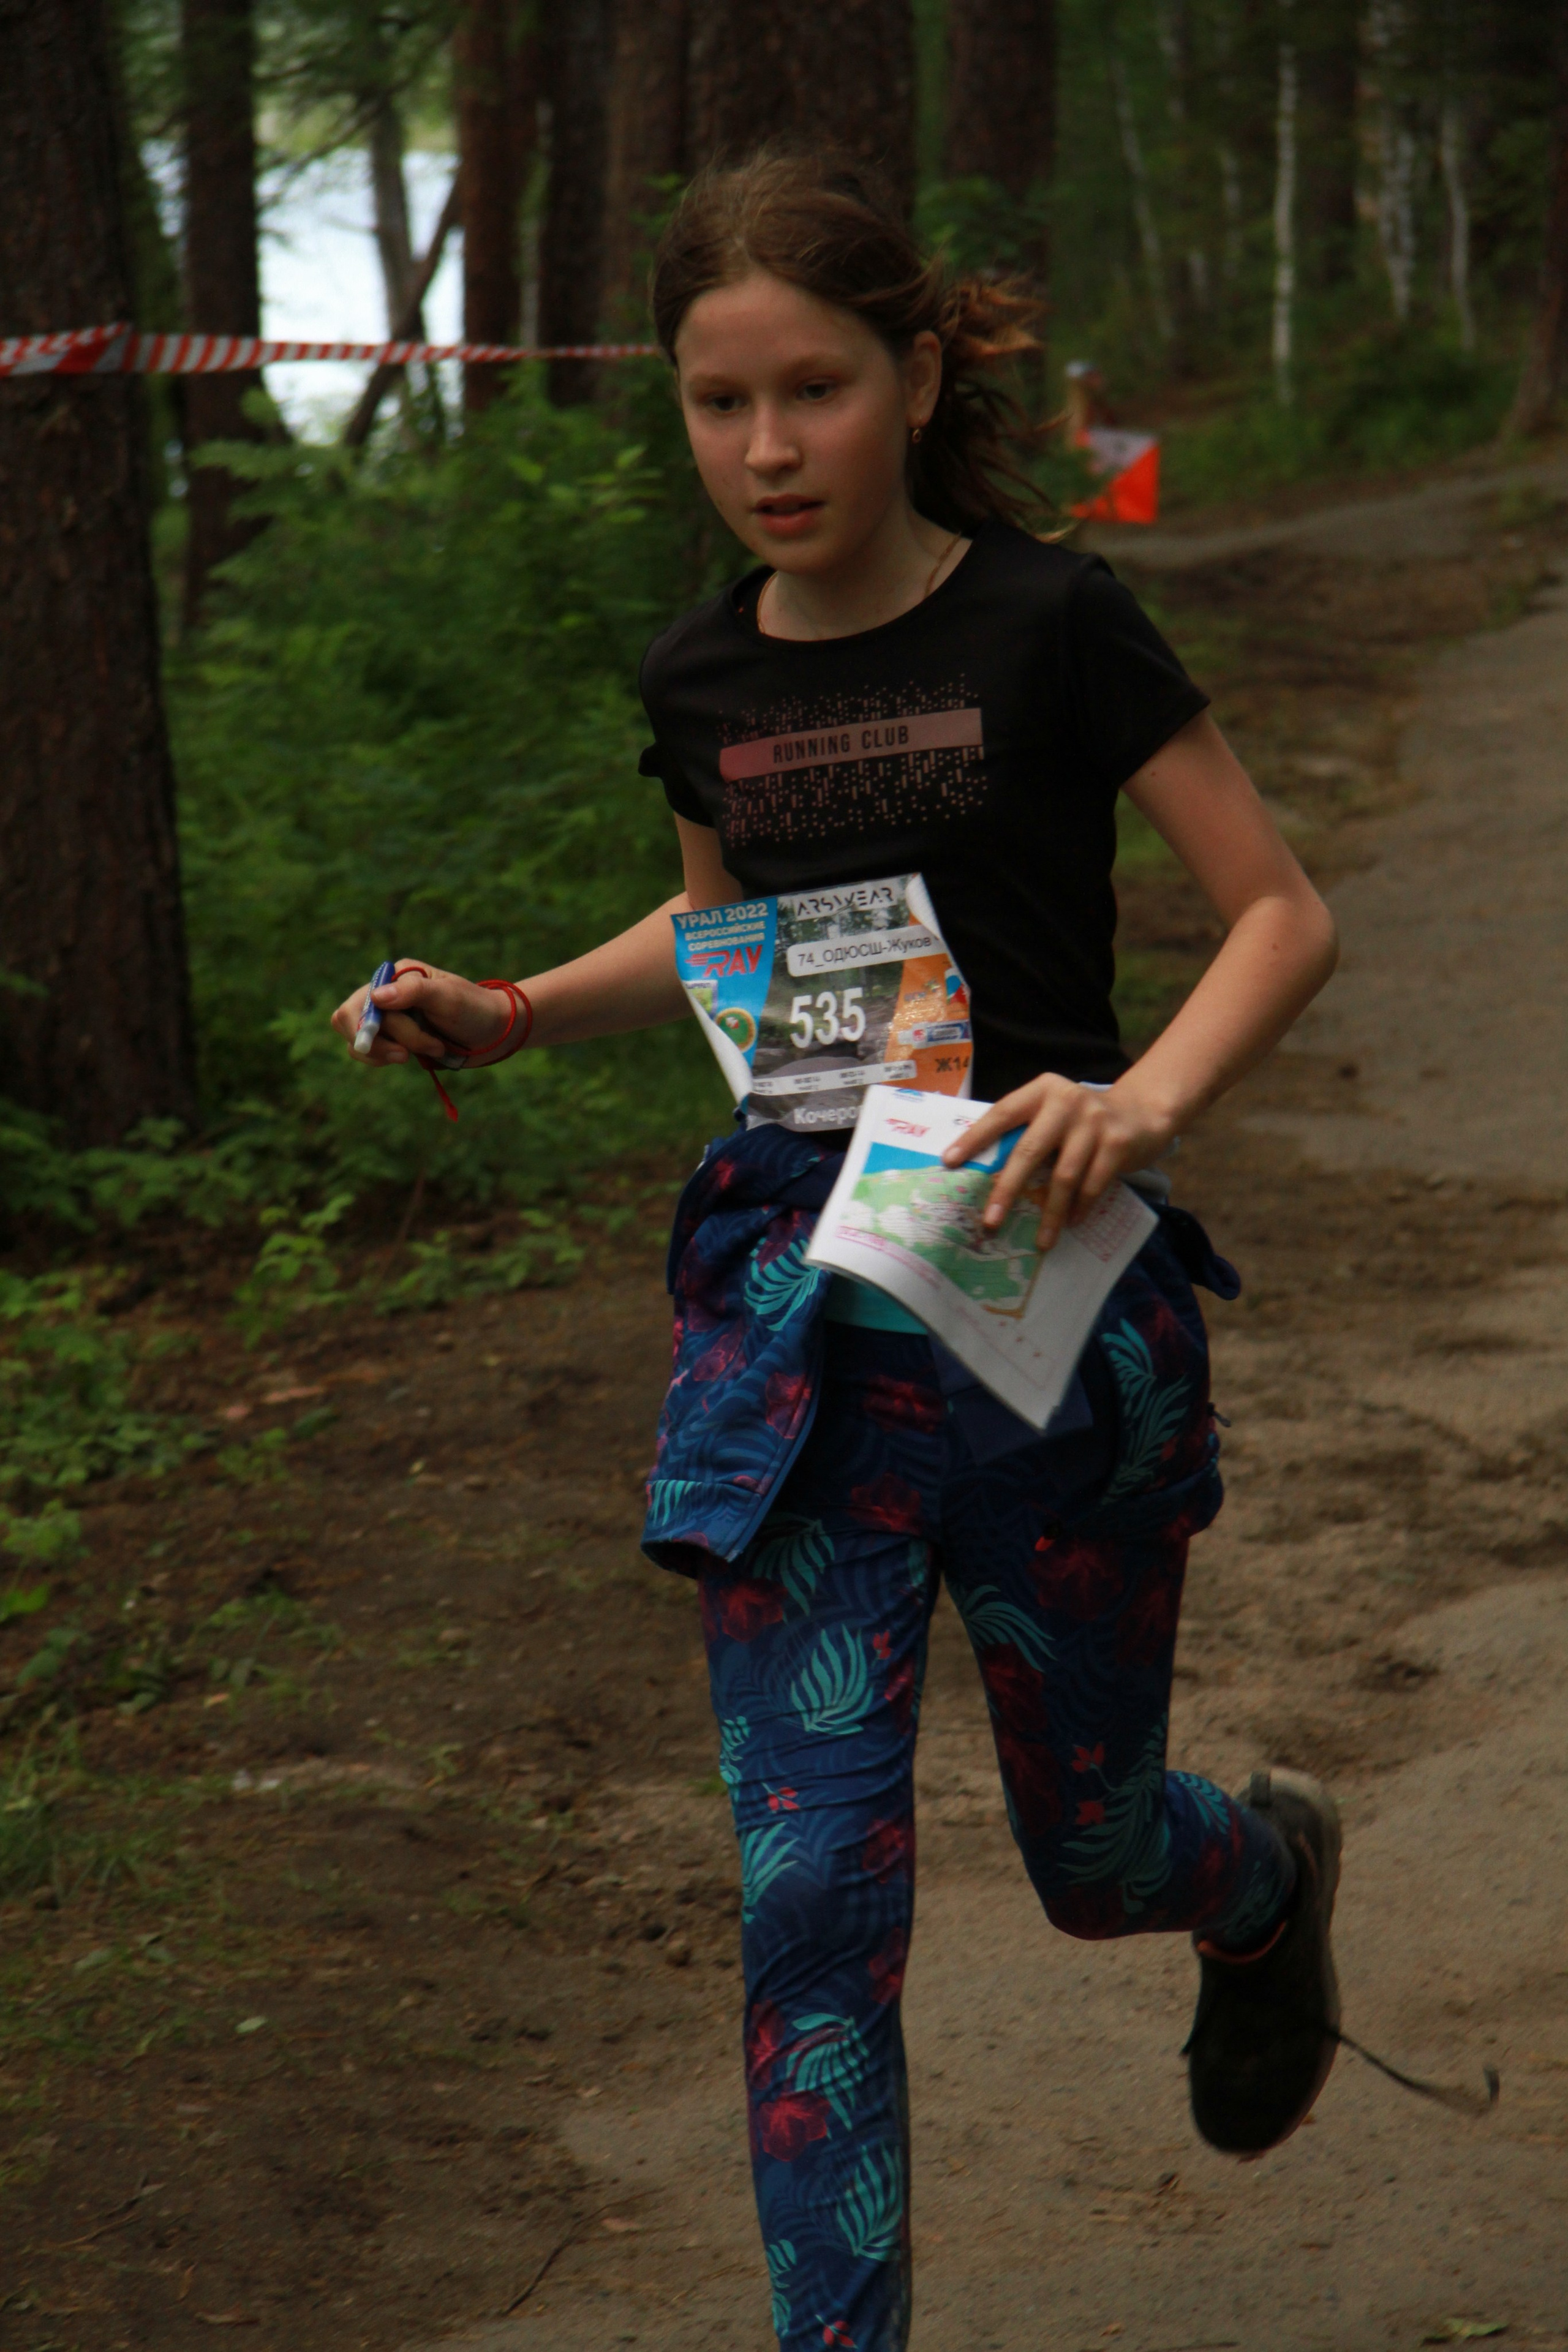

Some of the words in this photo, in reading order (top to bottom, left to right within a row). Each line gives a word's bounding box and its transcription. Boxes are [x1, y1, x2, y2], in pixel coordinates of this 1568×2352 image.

[773, 733, 850, 764] RUNNING
[861, 725, 910, 749] CLUB
[676, 910, 723, 929] УРАЛ
[724, 902, 768, 922] 2022
[685, 921, 766, 941] ВСЕРОССИЙСКИЕ
[688, 932, 765, 951] СОРЕВНОВАНИЯ
[797, 936, 940, 967] 74_ОДЮСШ-Жуков
[684, 944, 763, 978] RAY
[790, 987, 865, 1049] 535
